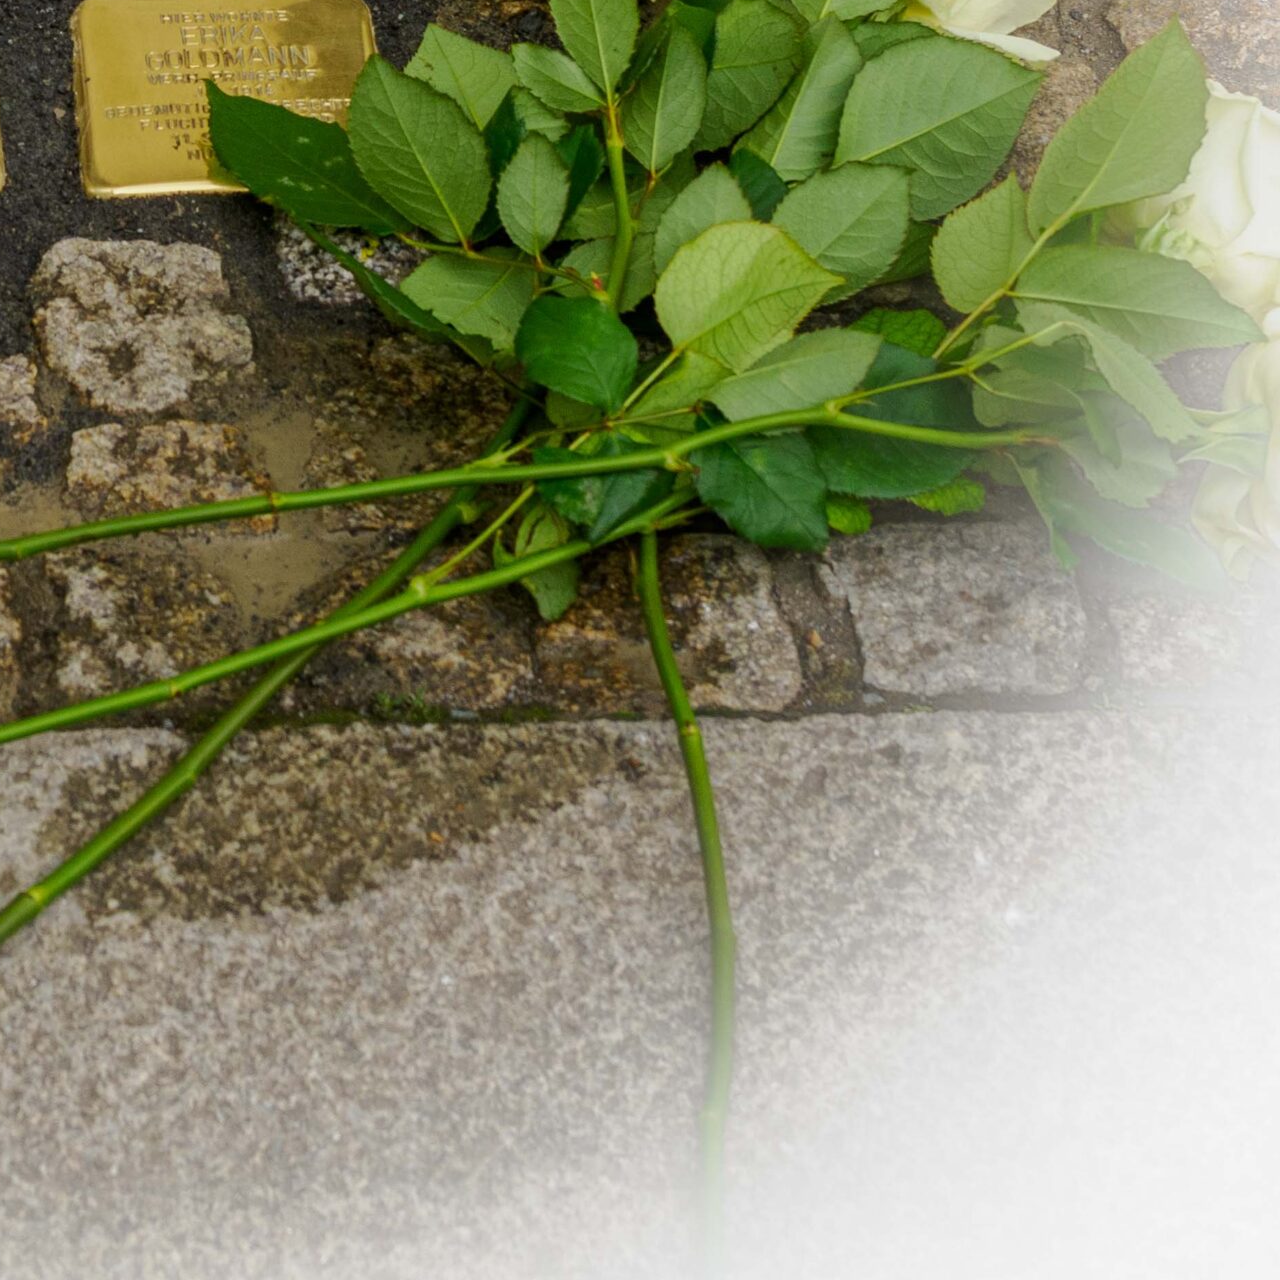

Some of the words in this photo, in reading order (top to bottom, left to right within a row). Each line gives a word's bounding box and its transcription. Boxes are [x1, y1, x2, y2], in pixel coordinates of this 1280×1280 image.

[160, 12, 205, 24] HIER
[210, 10, 289, 22] WOHNTE
[181, 25, 266, 47] ERIKA
[145, 45, 310, 70] GOLDMANN
